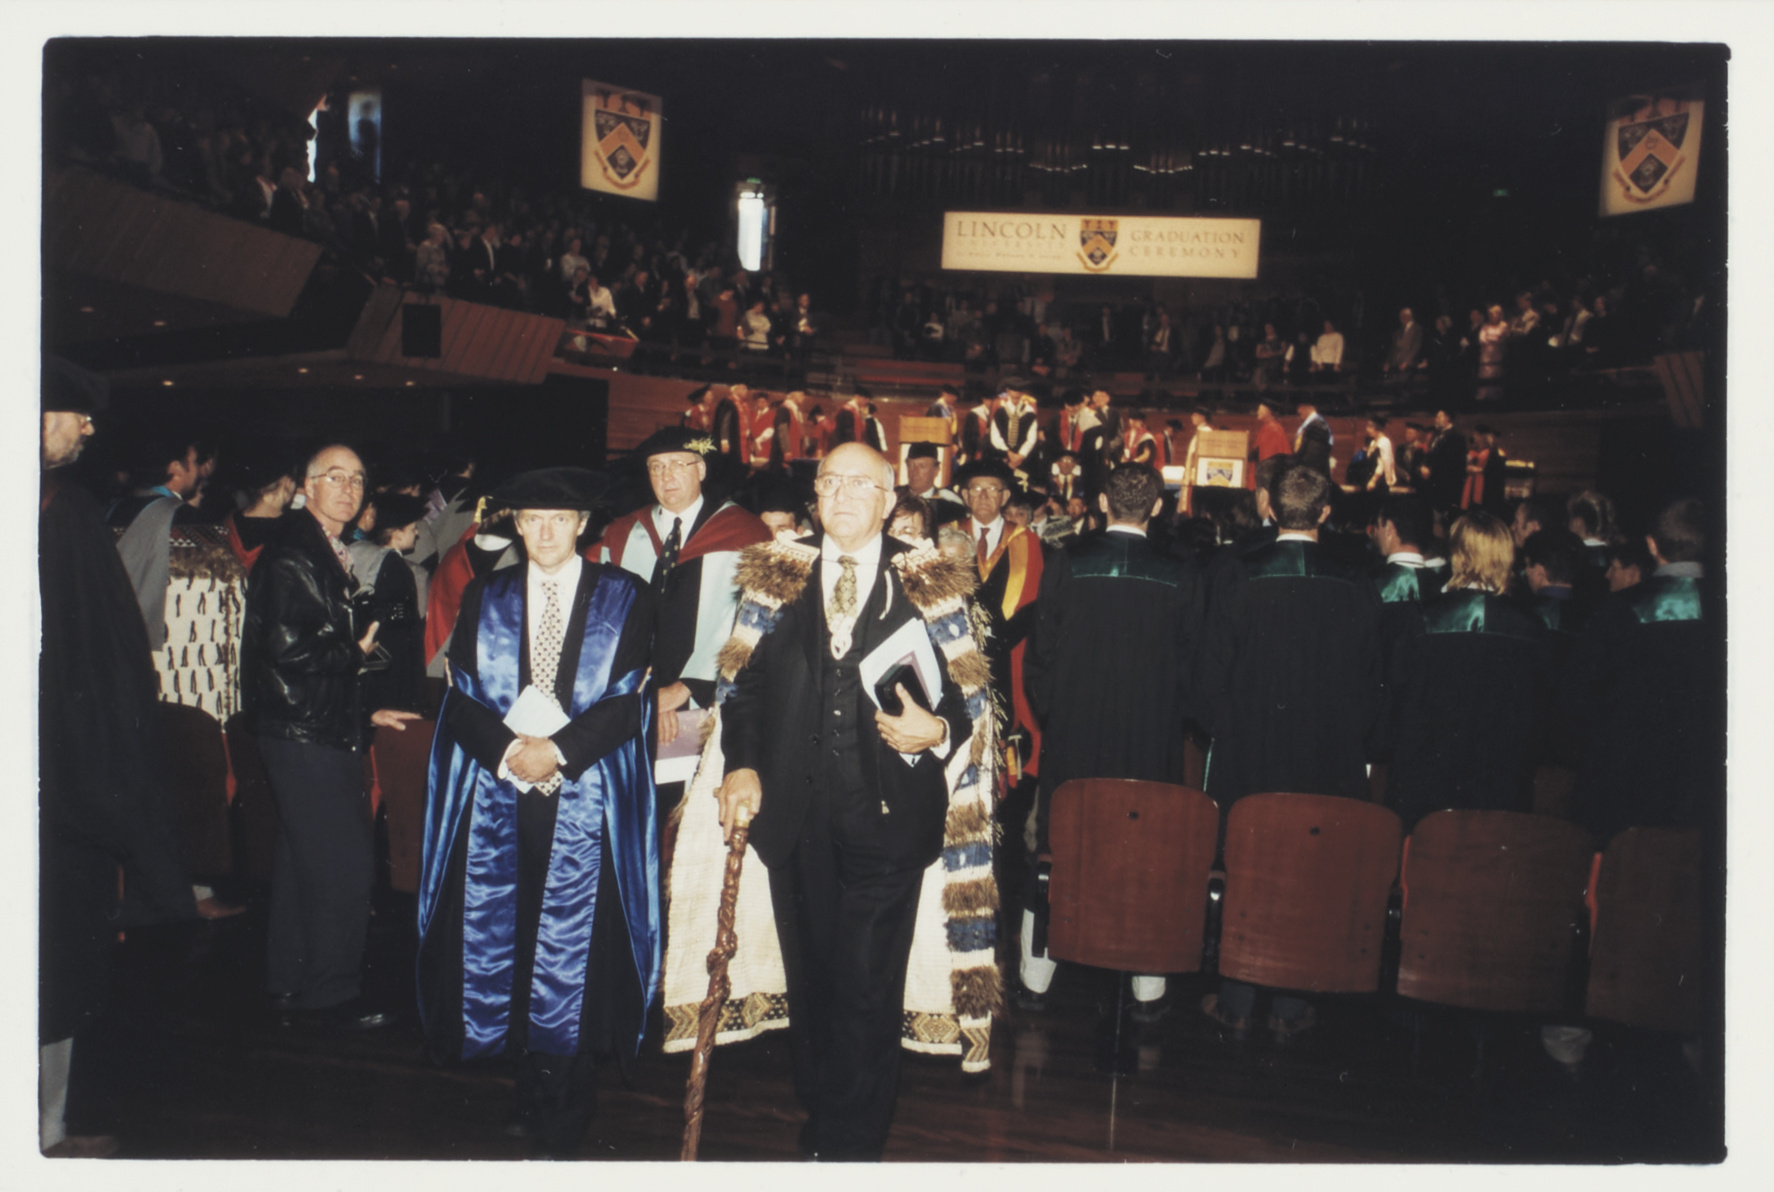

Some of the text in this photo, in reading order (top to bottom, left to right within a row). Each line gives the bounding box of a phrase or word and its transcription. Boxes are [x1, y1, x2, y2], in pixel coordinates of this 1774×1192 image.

[957, 220, 1067, 239] LINCOLN
[1130, 230, 1244, 244] GRADUATION
[1128, 246, 1239, 258] CEREMONY
